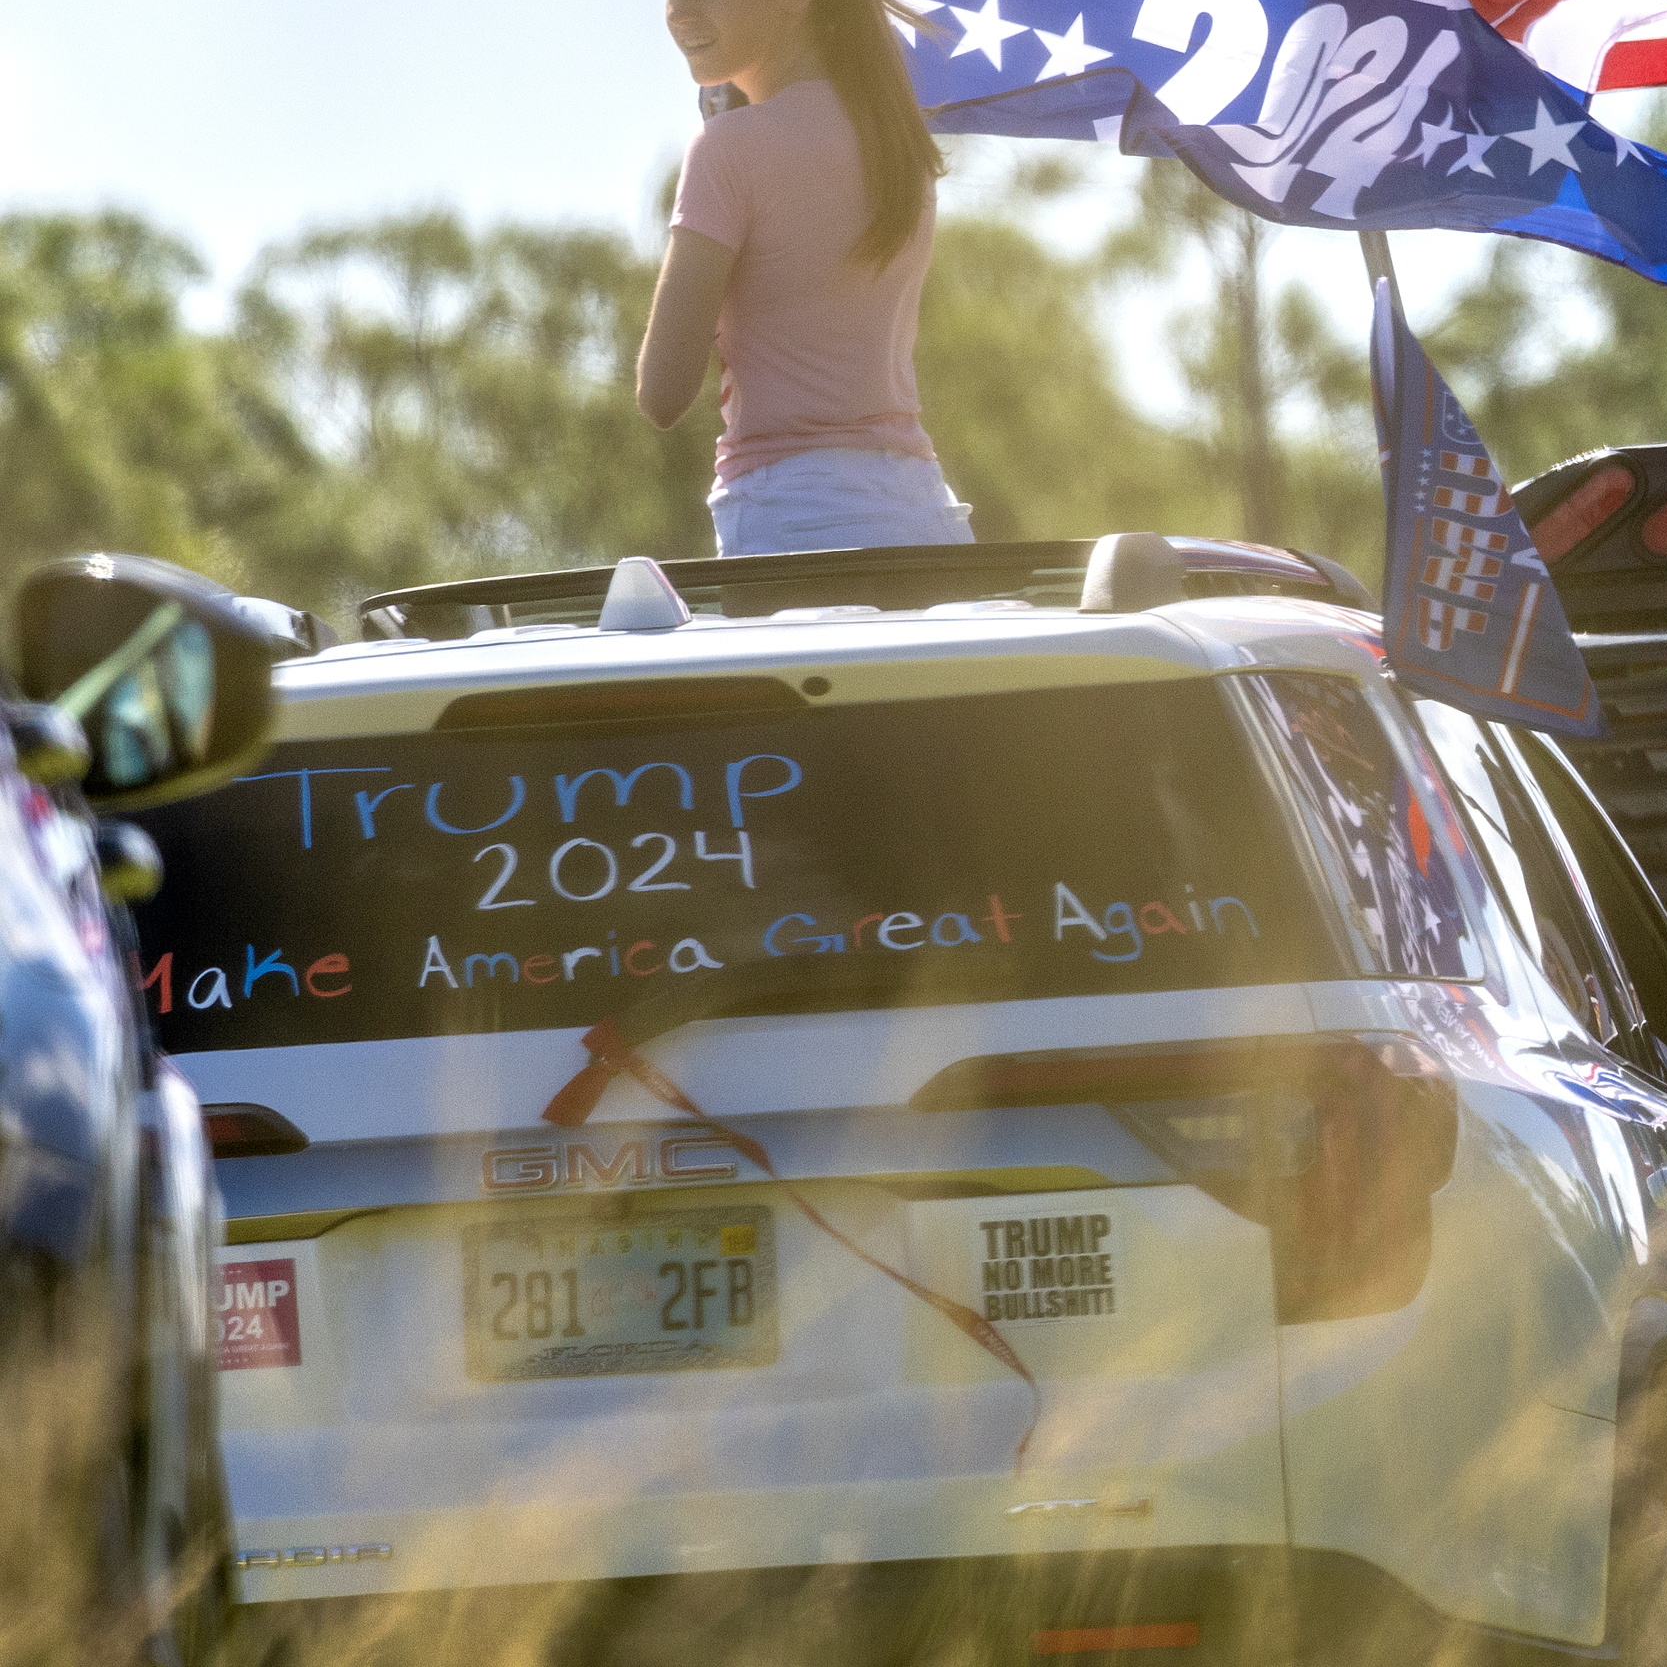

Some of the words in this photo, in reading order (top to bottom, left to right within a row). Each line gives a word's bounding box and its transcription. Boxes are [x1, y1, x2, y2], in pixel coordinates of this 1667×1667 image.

[232, 754, 802, 849] Trump
[474, 830, 756, 910] 2024
[419, 931, 724, 989] America
[762, 894, 1021, 957] Great
[1055, 881, 1259, 962] Again
[482, 1135, 738, 1192] GMC
[979, 1213, 1111, 1260] TRUMP
[217, 1280, 290, 1311] UMP
[657, 1258, 754, 1331] 2FB
[981, 1259, 1021, 1291] NO
[1029, 1253, 1113, 1289] MORE
[983, 1287, 1116, 1322] BULLSHIT!
